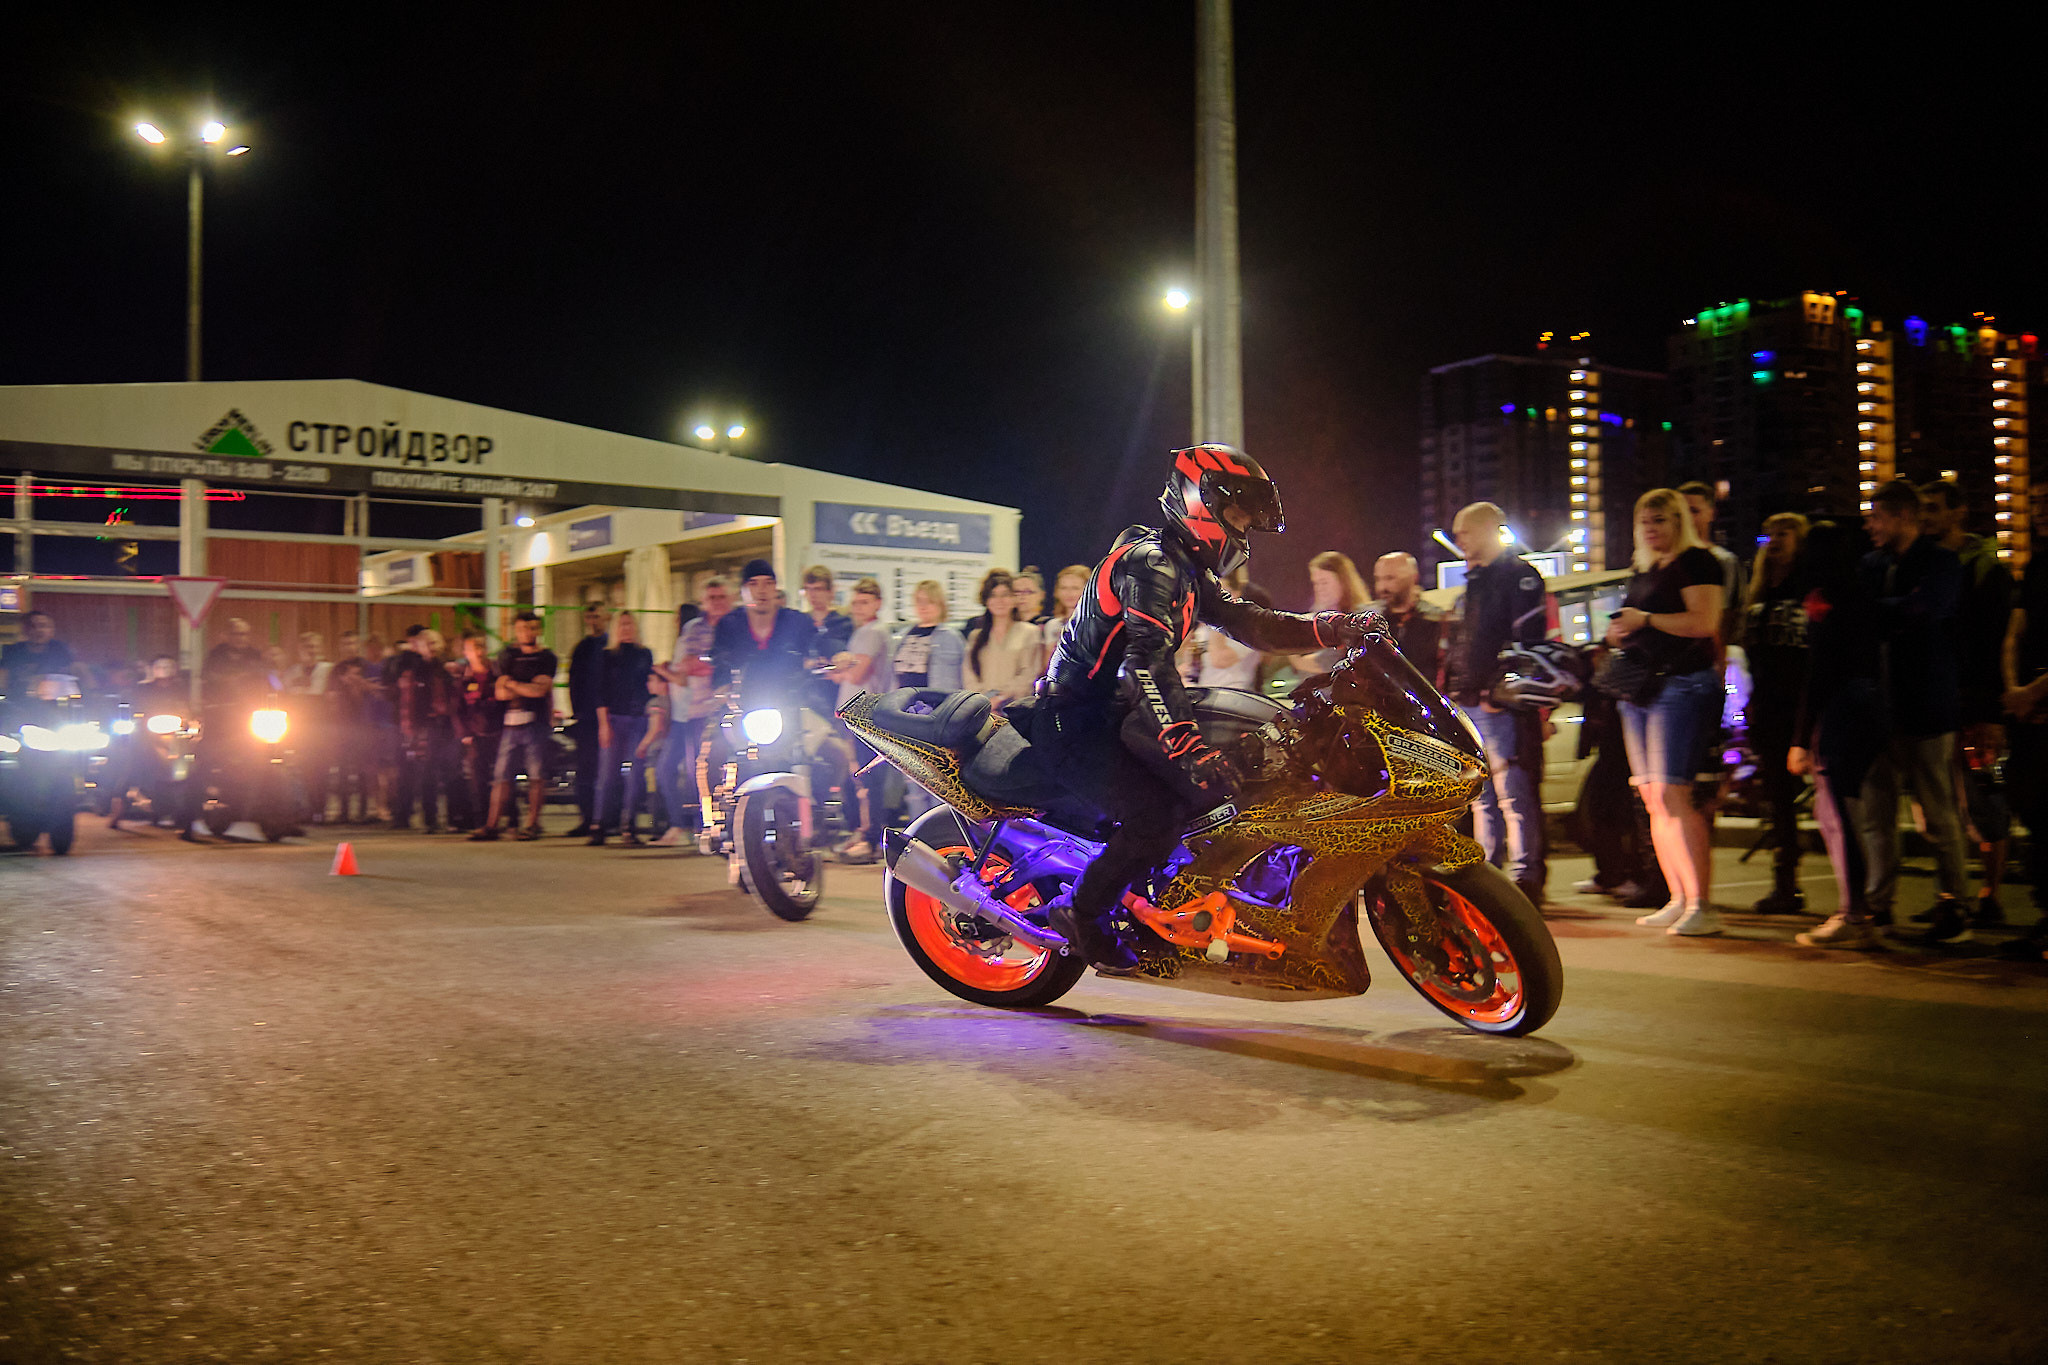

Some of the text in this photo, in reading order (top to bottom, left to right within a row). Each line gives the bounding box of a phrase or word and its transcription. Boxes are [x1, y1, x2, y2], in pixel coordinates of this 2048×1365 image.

[288, 420, 493, 466] СТРОЙДВОР
[886, 514, 961, 545] Въезд
[1134, 669, 1174, 730] DAINES
[1393, 738, 1457, 768] BRAZZERS
